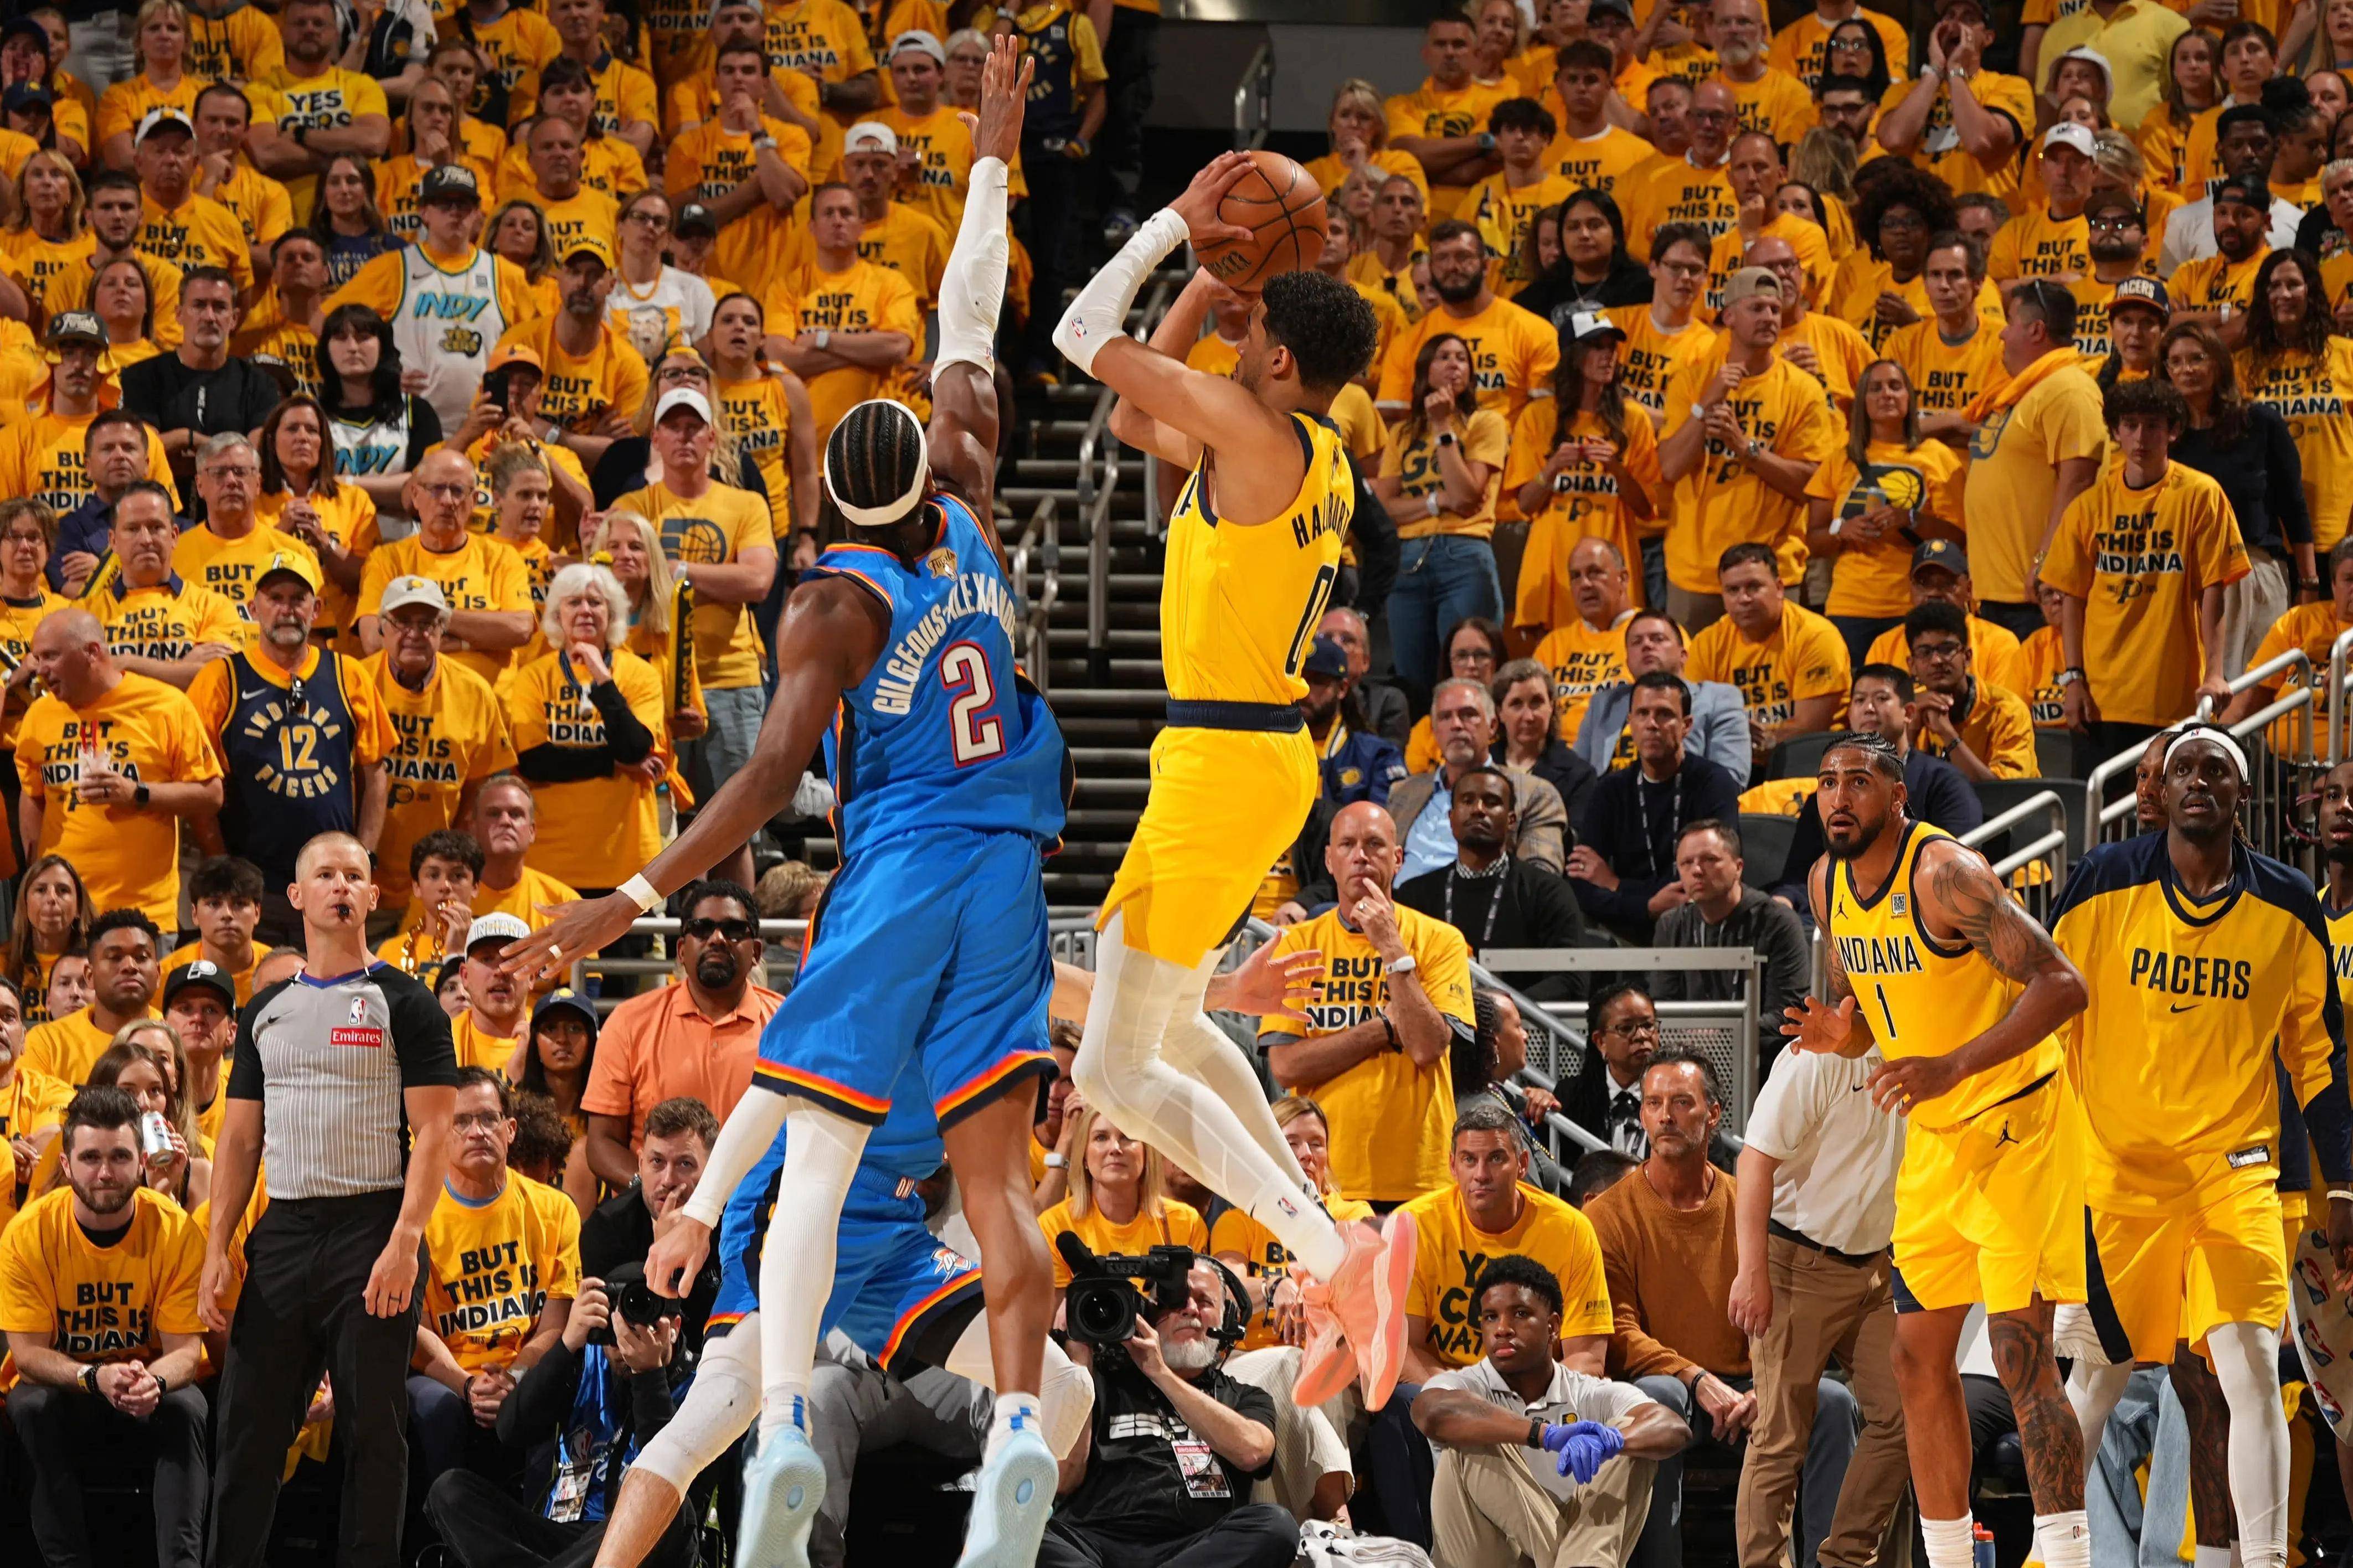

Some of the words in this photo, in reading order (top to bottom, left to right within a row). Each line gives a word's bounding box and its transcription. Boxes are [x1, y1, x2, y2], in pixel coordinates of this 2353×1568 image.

[769, 24, 807, 37] BUT
[768, 38, 802, 51] HIS
[809, 34, 827, 48] IS
[770, 51, 837, 68] DIANA
[1796, 58, 1822, 73] TH
[287, 90, 342, 112] YES
[1737, 102, 1759, 116] UT
[928, 152, 946, 165] IS
[1562, 160, 1602, 176] BUT
[1681, 187, 1723, 202] BUT
[1667, 203, 1709, 220] THIS
[1716, 205, 1736, 218] IS
[184, 245, 206, 260] IS
[857, 241, 884, 258] UT
[2037, 240, 2076, 256] BUT
[2068, 254, 2087, 270] IS
[414, 293, 491, 322] INDY
[817, 293, 853, 310] BUT
[849, 310, 868, 325] IS
[2075, 319, 2109, 334] HIS
[1477, 354, 1497, 368] IS
[1629, 350, 1671, 370] BUT
[549, 374, 593, 394] BUT
[1624, 366, 1657, 388] HIS
[1928, 372, 1968, 388] BUT
[2311, 381, 2334, 394] IS
[542, 396, 578, 411] HIS
[1916, 390, 1955, 408] THIS
[730, 415, 749, 431] IS
[1754, 421, 1776, 439] IS
[57, 451, 89, 468] BU
[334, 445, 399, 476] NDY
[40, 472, 93, 489] THIS
[2115, 513, 2157, 530] BUT
[2097, 533, 2146, 552] THIS
[2151, 532, 2174, 548] IS
[205, 565, 255, 582] BUT
[220, 585, 245, 601] IS
[436, 577, 468, 596] UT
[465, 595, 487, 608] IS
[125, 608, 168, 623] BUT
[1284, 564, 1336, 678] 0
[105, 623, 159, 642] THIS
[164, 622, 186, 637] IS
[1568, 652, 1615, 666] BUT
[1552, 666, 1598, 683] THIS
[1603, 664, 1621, 678] IS
[1733, 666, 1772, 686] BUT
[1743, 687, 1766, 705] IS
[1772, 683, 1789, 702] IS
[940, 641, 1005, 768] 2
[244, 702, 341, 739] INDNA
[278, 725, 320, 771] 12
[393, 737, 419, 756] IS
[428, 737, 450, 755] IS
[385, 757, 456, 780] DIANA
[254, 763, 339, 798] PACERS
[2130, 947, 2252, 1000] PACERS
[1311, 981, 1373, 1003] THIS
[1876, 982, 1897, 1040] 1
[332, 1031, 382, 1044] Emirates
[461, 1240, 519, 1275] BUT
[76, 1282, 133, 1305] BUT
[442, 1272, 513, 1306] THIS
[56, 1307, 121, 1333] THIS
